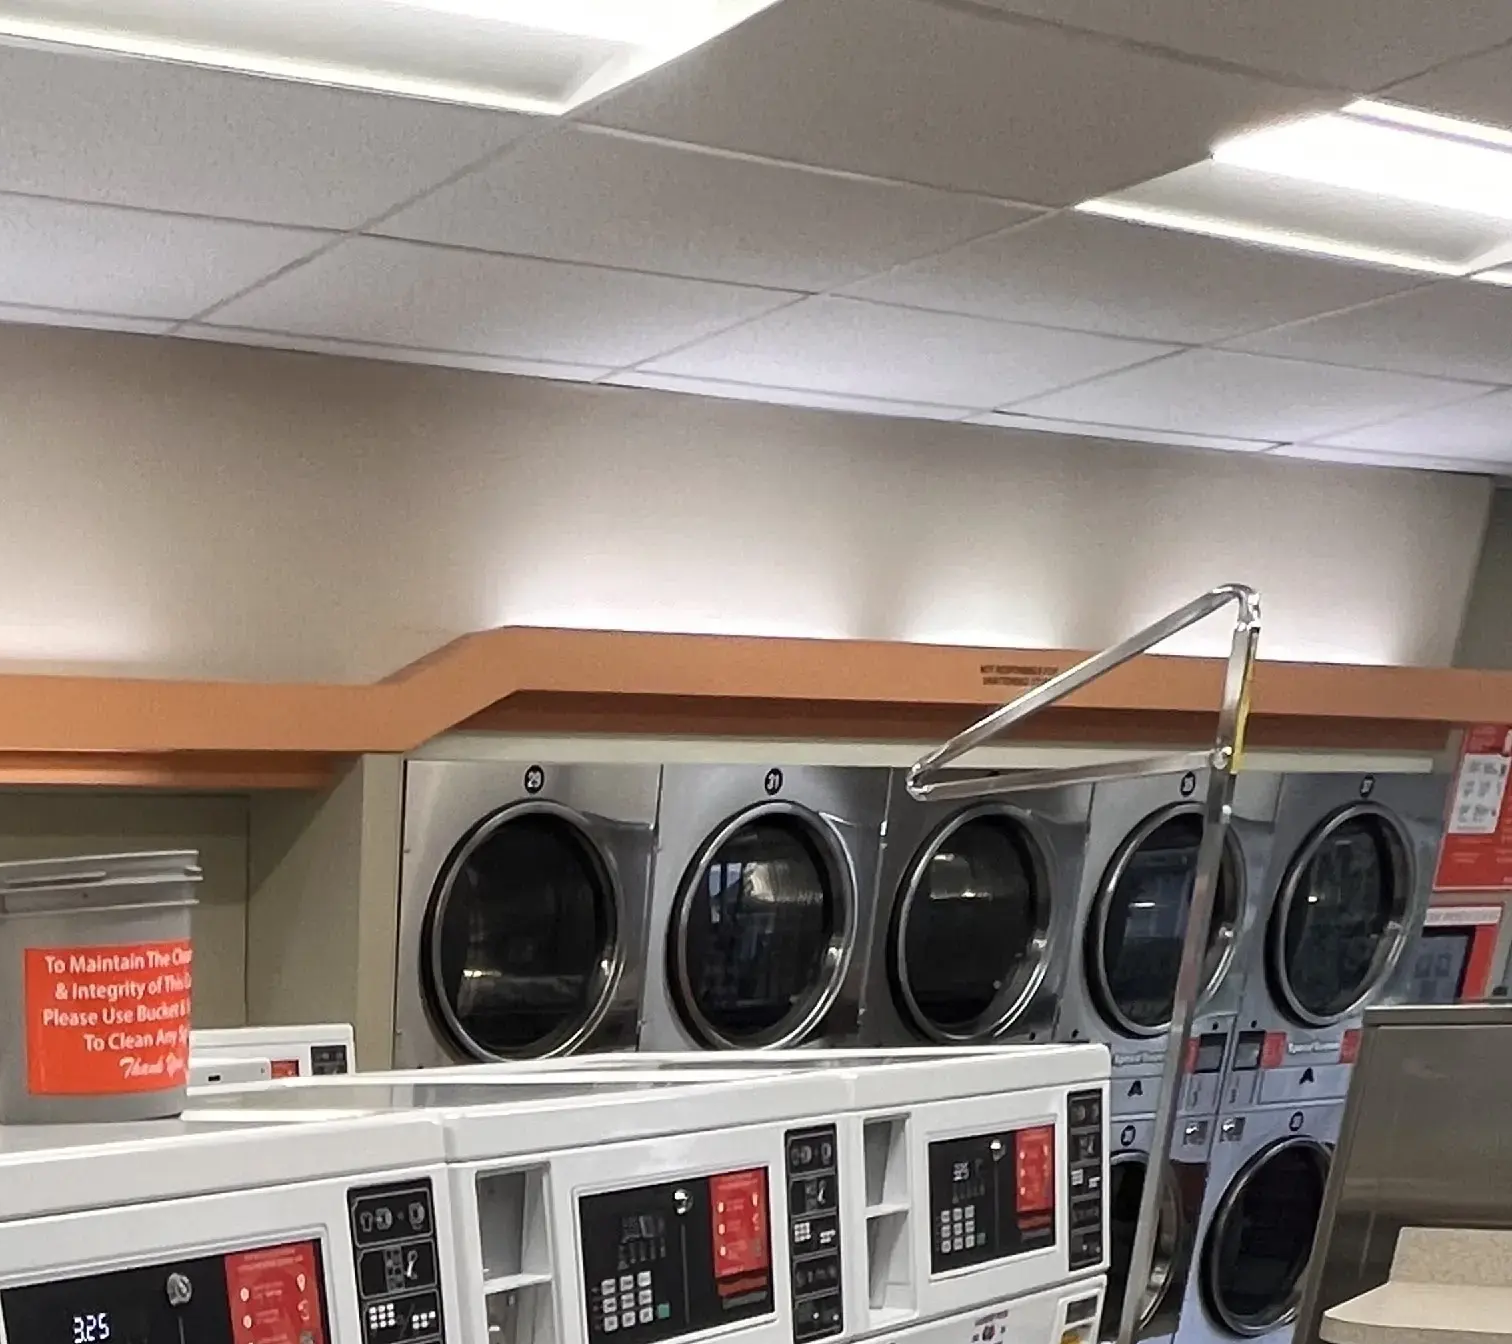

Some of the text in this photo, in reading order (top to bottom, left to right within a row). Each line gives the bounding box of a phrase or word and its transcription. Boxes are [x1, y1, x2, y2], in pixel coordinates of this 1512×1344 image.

[45, 955, 65, 974] To
[69, 953, 145, 974] Maintain
[146, 950, 171, 968] The
[55, 982, 68, 1000] &
[72, 980, 146, 1002] Integrity
[148, 975, 163, 995] of
[43, 1008, 98, 1026] Please
[102, 1007, 134, 1025] Use
[84, 1033, 105, 1052] To
[108, 1032, 153, 1051] Clean
